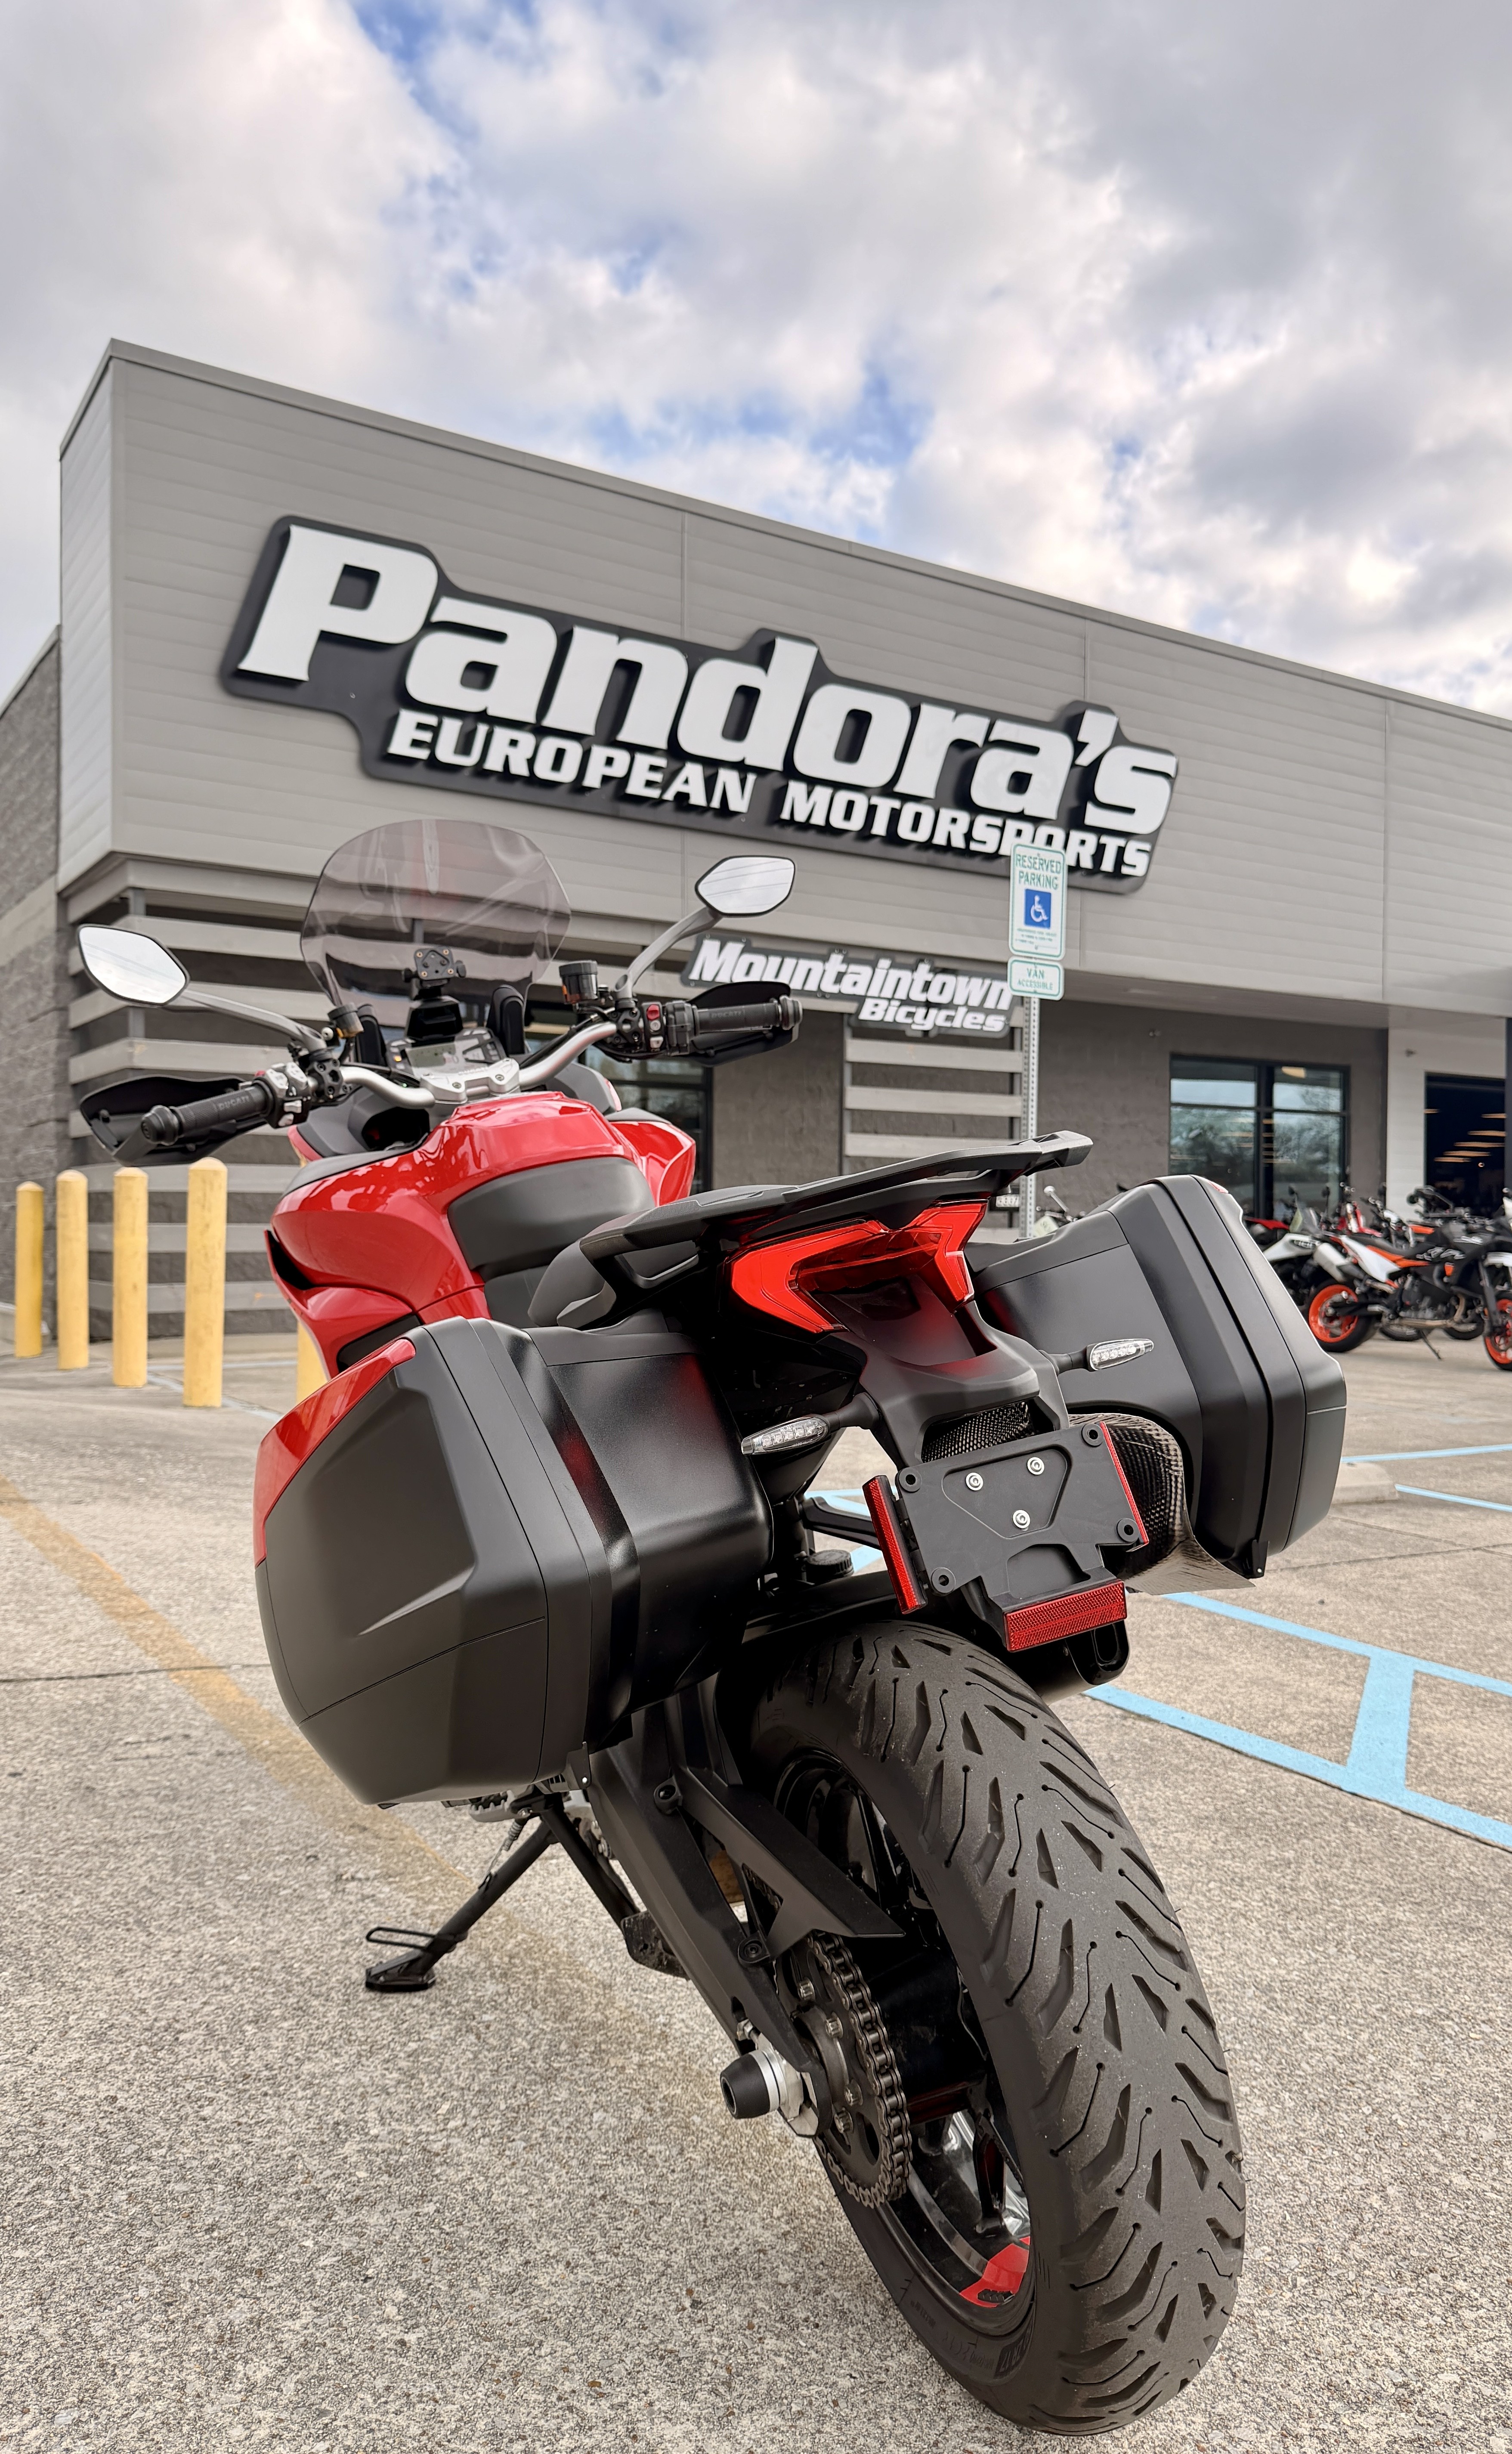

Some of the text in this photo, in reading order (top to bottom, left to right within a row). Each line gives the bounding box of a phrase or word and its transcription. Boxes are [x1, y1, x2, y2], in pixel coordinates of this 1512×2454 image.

[237, 524, 1178, 836] Pandora's
[388, 709, 1151, 877] EUROPEAN MOTORSPORTS
[1015, 854, 1061, 874] RESERVED
[1018, 871, 1058, 890] PARKING
[689, 939, 1011, 1010] Mountaintown
[1017, 979, 1053, 990] ACCESSIBLE
[1027, 968, 1045, 979] VAN
[859, 998, 1007, 1032] Bicycles
